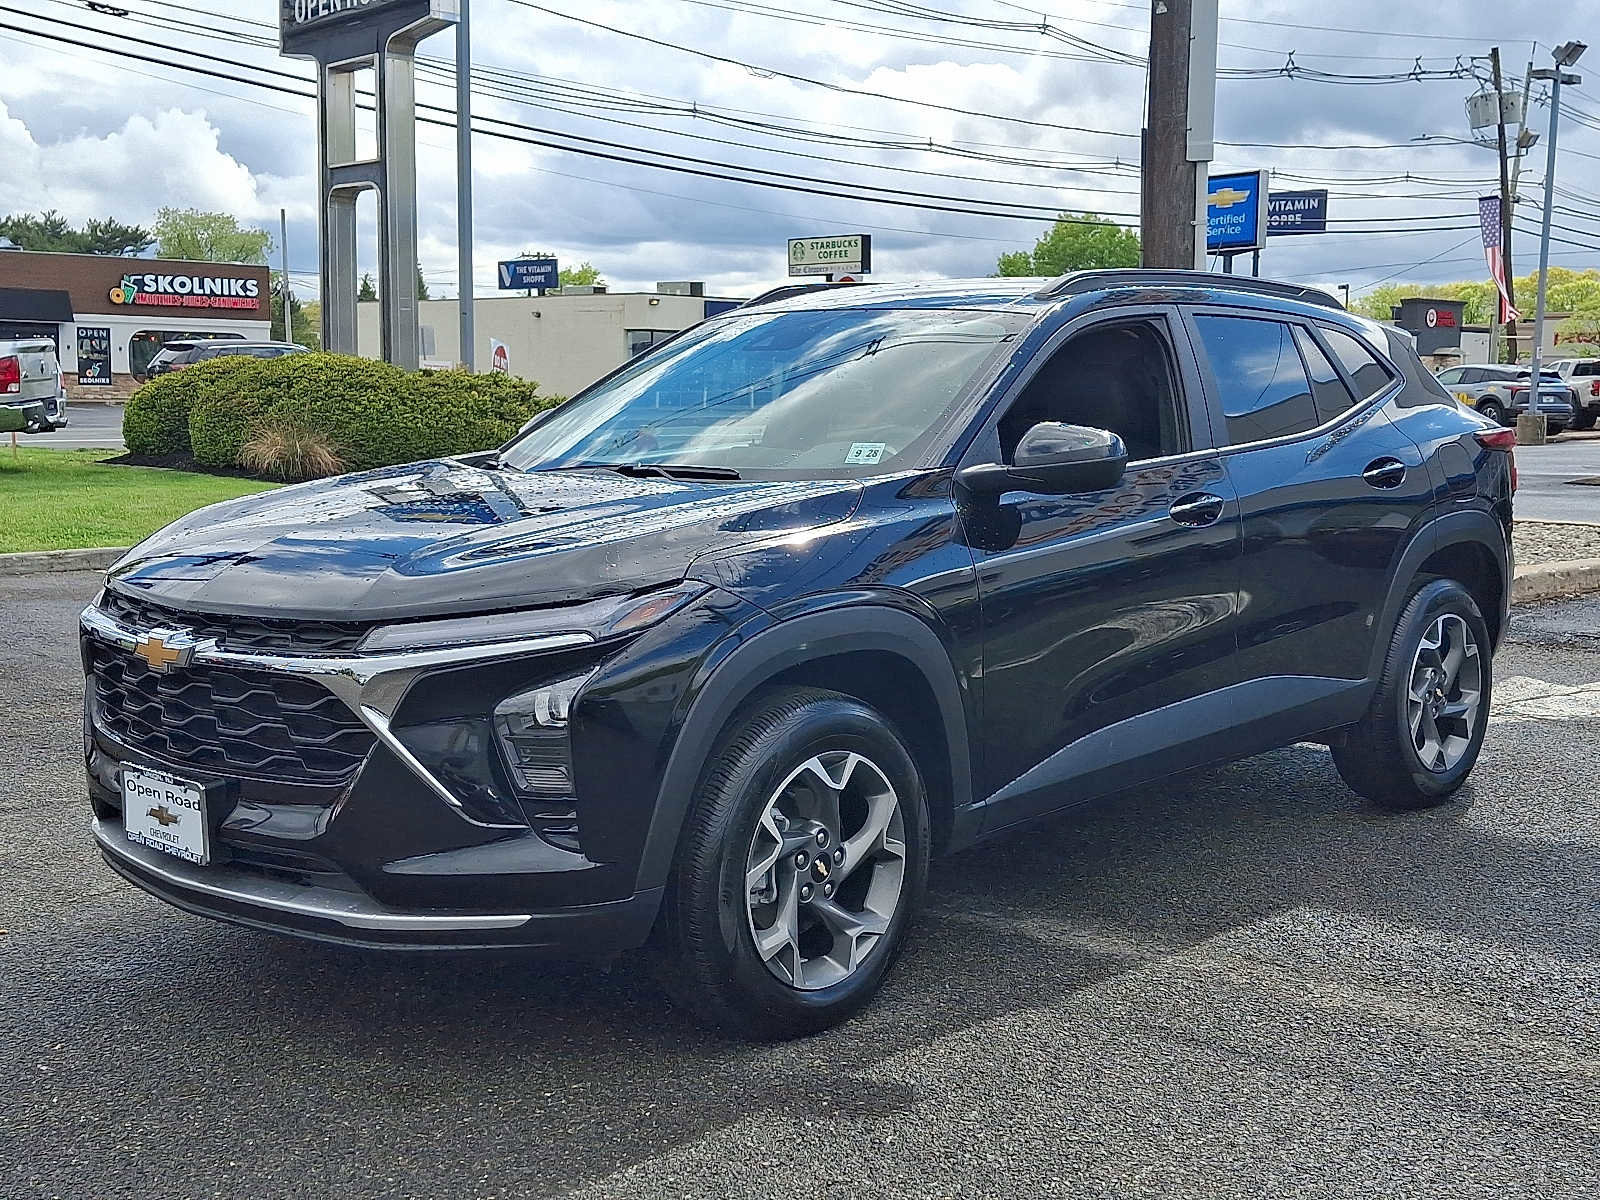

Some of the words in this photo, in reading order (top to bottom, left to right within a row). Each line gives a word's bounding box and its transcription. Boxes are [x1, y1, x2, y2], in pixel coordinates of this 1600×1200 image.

[1267, 198, 1319, 212] VITAMIN
[810, 239, 858, 250] STARBUCKS
[818, 249, 849, 259] COFFEE
[528, 265, 551, 273] VITAMIN
[523, 275, 544, 283] SHOPPE
[143, 275, 259, 296] SKOLNIKS
[79, 329, 106, 337] OPEN
[855, 449, 862, 457] 9
[865, 449, 879, 457] 28
[126, 779, 161, 800] Open
[165, 790, 201, 812] Road
[149, 827, 180, 844] CHEVROLET
[127, 831, 145, 845] OPEN
[145, 838, 164, 851] ROAD
[164, 843, 202, 864] CHEVROLET
